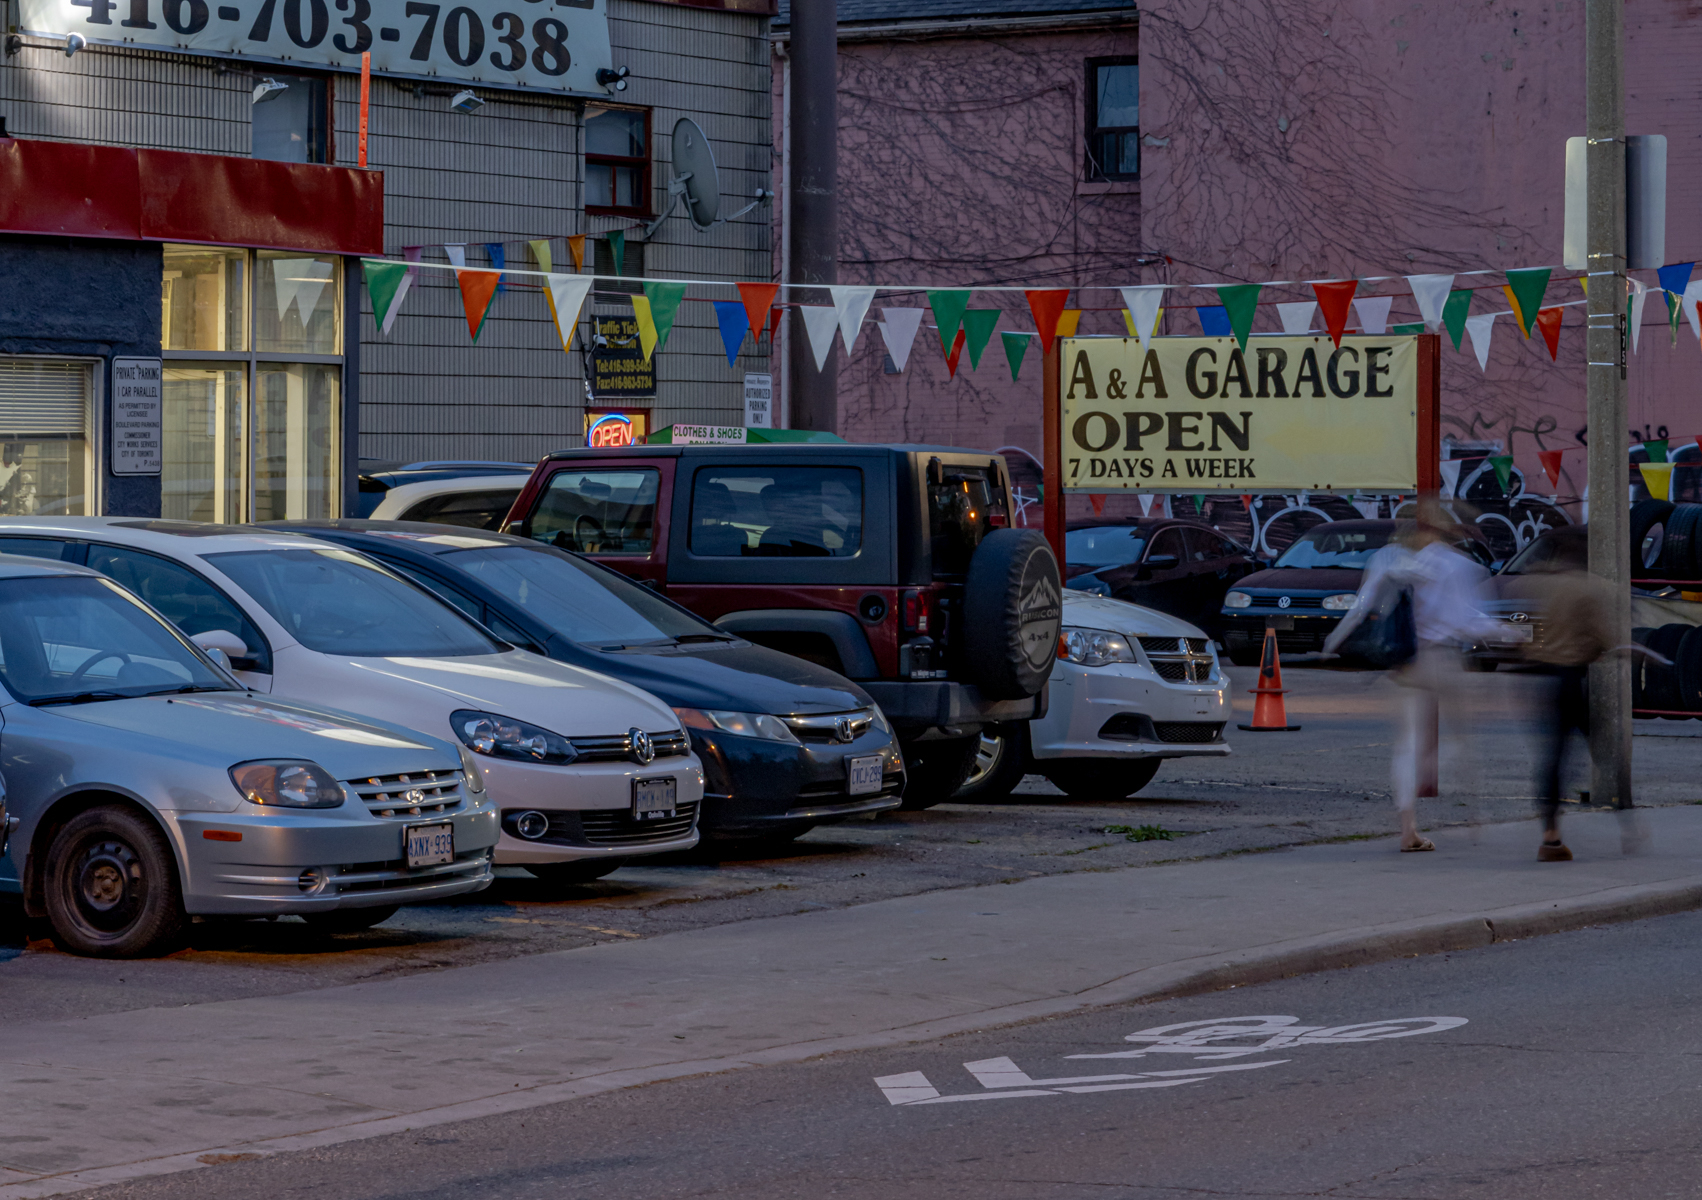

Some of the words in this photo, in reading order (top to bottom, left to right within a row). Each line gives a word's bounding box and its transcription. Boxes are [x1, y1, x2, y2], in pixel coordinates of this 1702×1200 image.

[593, 320, 620, 335] Traffic
[115, 366, 136, 380] PRIVATE
[138, 367, 159, 380] PARKING
[1066, 349, 1098, 399] A
[1106, 368, 1128, 400] &
[1135, 348, 1168, 399] A
[1185, 346, 1394, 399] GARAGE
[121, 386, 132, 397] CAR
[133, 386, 158, 398] PARALLEL
[746, 387, 771, 400] AUTHORIZED
[118, 402, 125, 410] AS
[125, 402, 150, 410] PERMITTED
[150, 402, 157, 410] BY
[749, 400, 767, 412] PARKING
[126, 410, 148, 418] LICENSEE
[753, 412, 763, 424] ONLY
[141, 421, 160, 429] PARKING
[1072, 411, 1253, 452] OPEN
[591, 421, 633, 447] OPEN
[673, 426, 707, 438] CLOTHES
[709, 427, 715, 438] &
[717, 427, 743, 440] SHOES
[1068, 458, 1081, 478] 7
[1089, 458, 1154, 479] DAYS
[1161, 458, 1178, 478] A
[1185, 458, 1256, 479] WEEK
[1022, 608, 1059, 622] RUBICON
[1028, 631, 1049, 642] 4x4
